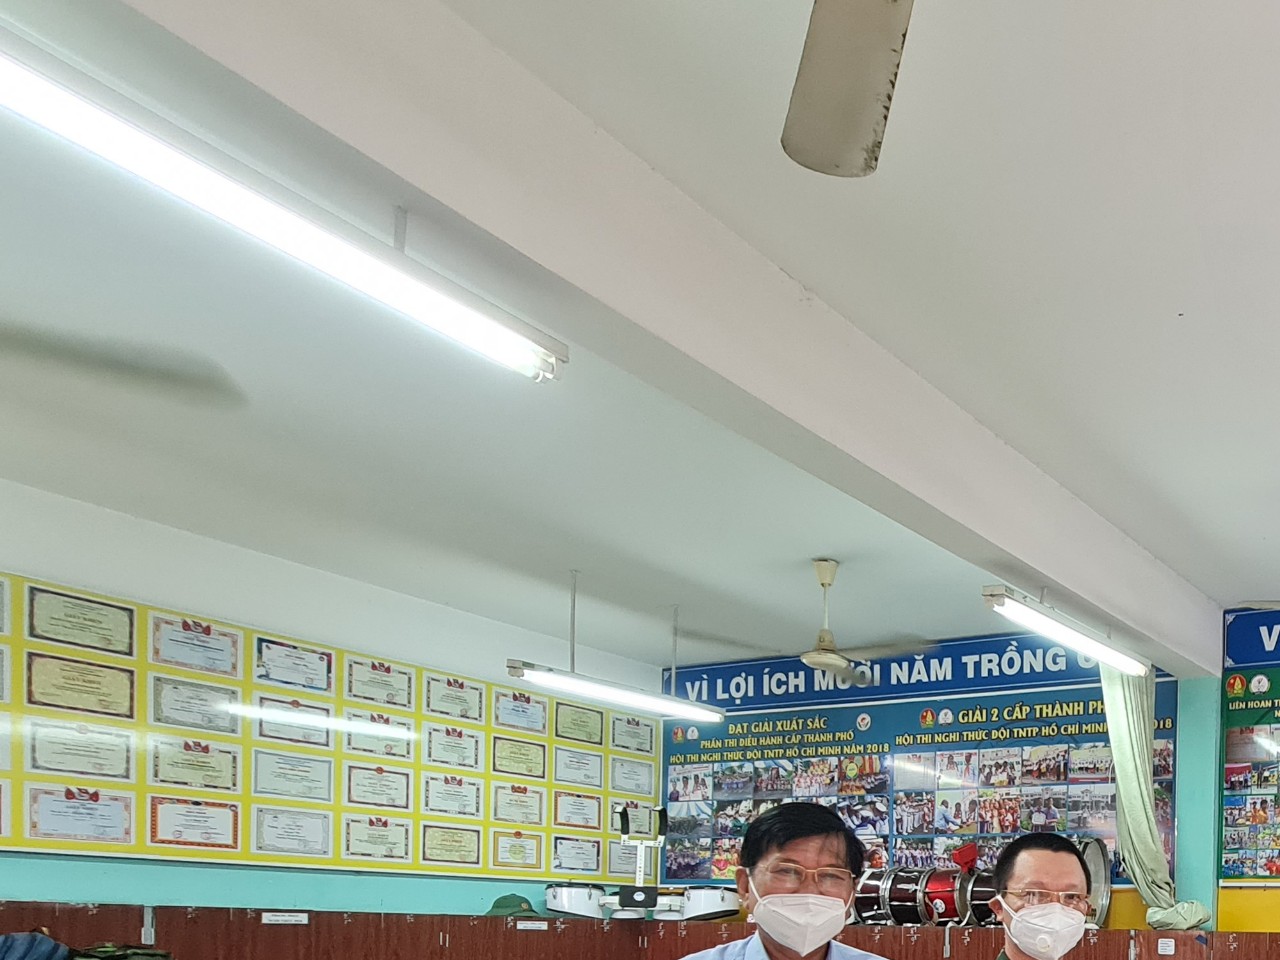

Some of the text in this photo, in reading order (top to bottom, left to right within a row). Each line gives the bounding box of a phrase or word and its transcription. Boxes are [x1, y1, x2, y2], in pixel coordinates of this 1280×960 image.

[685, 674, 708, 702] VÌ
[716, 671, 754, 704] LỢI
[763, 667, 805, 696] ÍCH
[890, 654, 952, 685] NĂM
[962, 641, 1067, 678] TRỒNG
[958, 700, 1107, 724] GIẢI 2 CẤP THÀNH PH
[1247, 698, 1272, 709] HOAN
[728, 714, 828, 735] ĐẠT GIẢI XUẤT SẮC
[724, 738, 737, 747] THI
[895, 732, 914, 747] HỘI
[916, 733, 932, 745] THI
[934, 731, 960, 744] NGHI
[962, 727, 989, 742] THỨC
[1012, 725, 1039, 739] TNTP
[686, 753, 700, 763] THI
[701, 752, 721, 763] NGHI
[763, 749, 784, 759] TNTP
[818, 745, 841, 756] MINH
[866, 743, 889, 754] 2018
